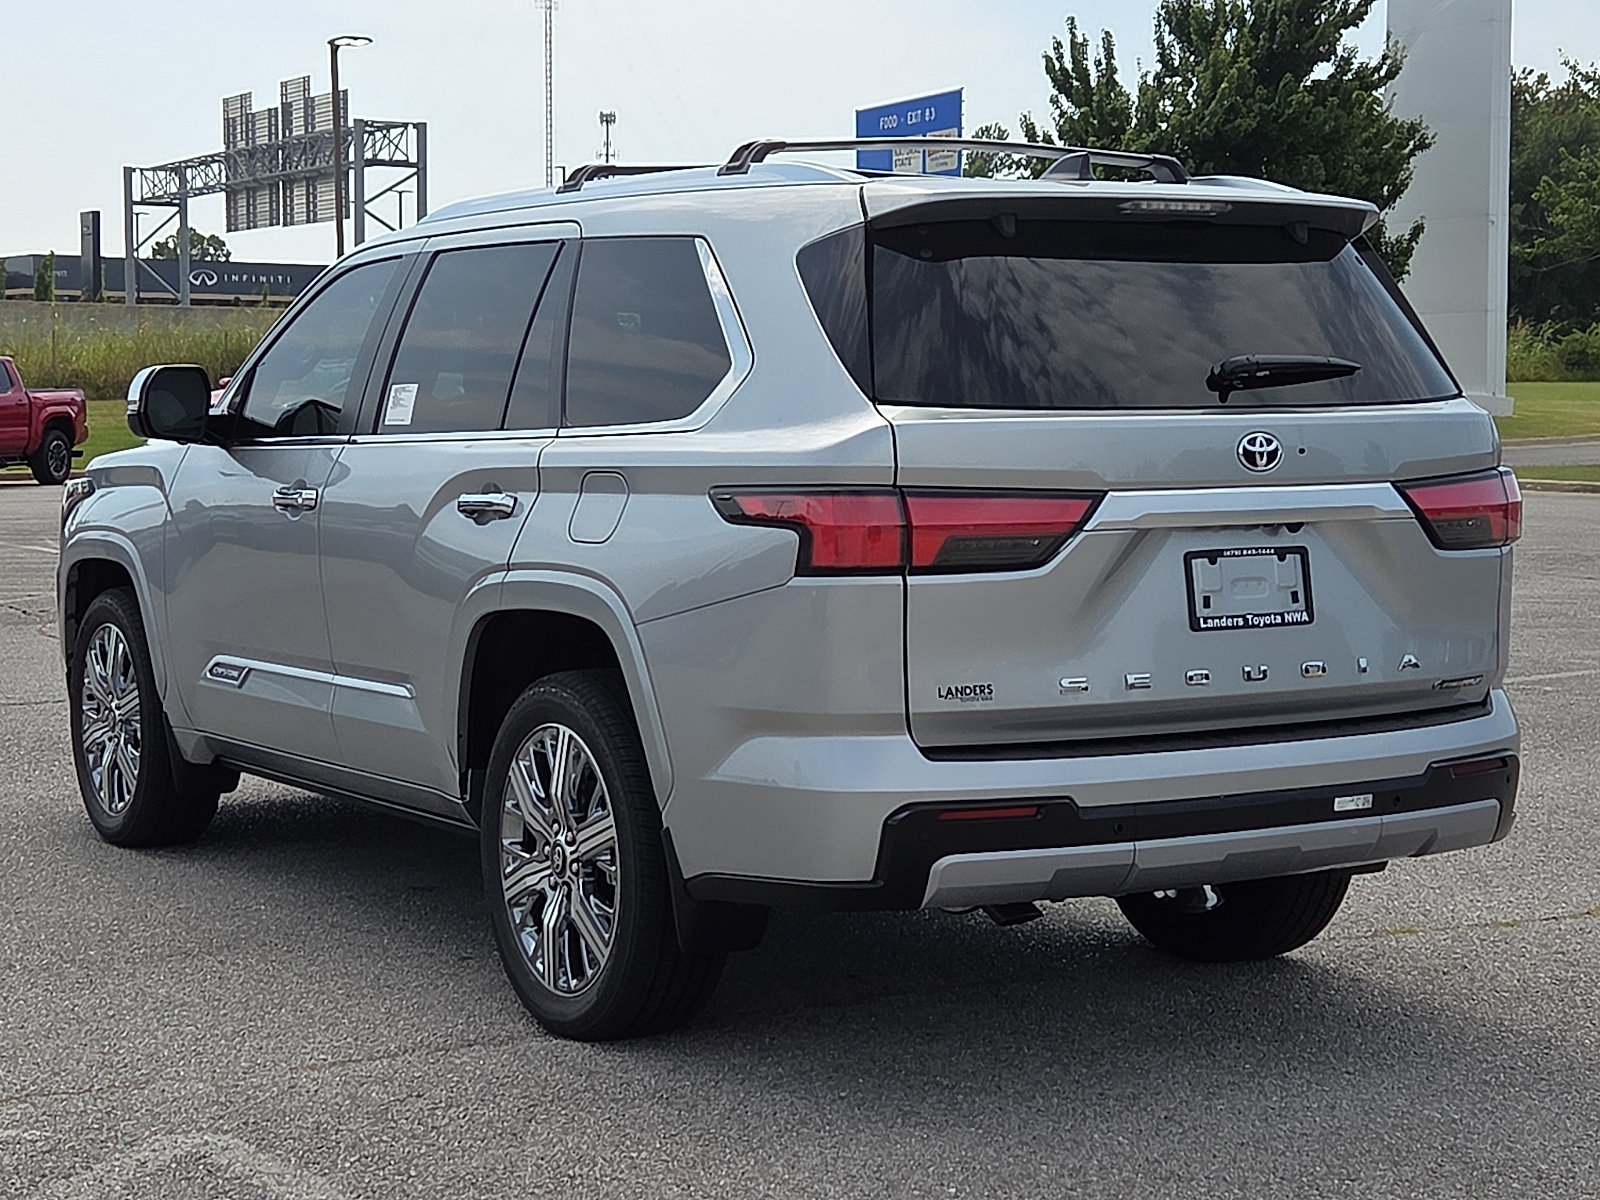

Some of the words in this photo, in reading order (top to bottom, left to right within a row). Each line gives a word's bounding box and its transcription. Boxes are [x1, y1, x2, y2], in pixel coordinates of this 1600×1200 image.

[880, 114, 898, 130] FOOD
[907, 109, 921, 125] EXIT
[223, 273, 291, 284] INFINITI
[1200, 617, 1244, 628] Landers
[1246, 614, 1282, 627] Toyota
[1284, 611, 1309, 623] NWA
[938, 683, 993, 699] LANDERS
